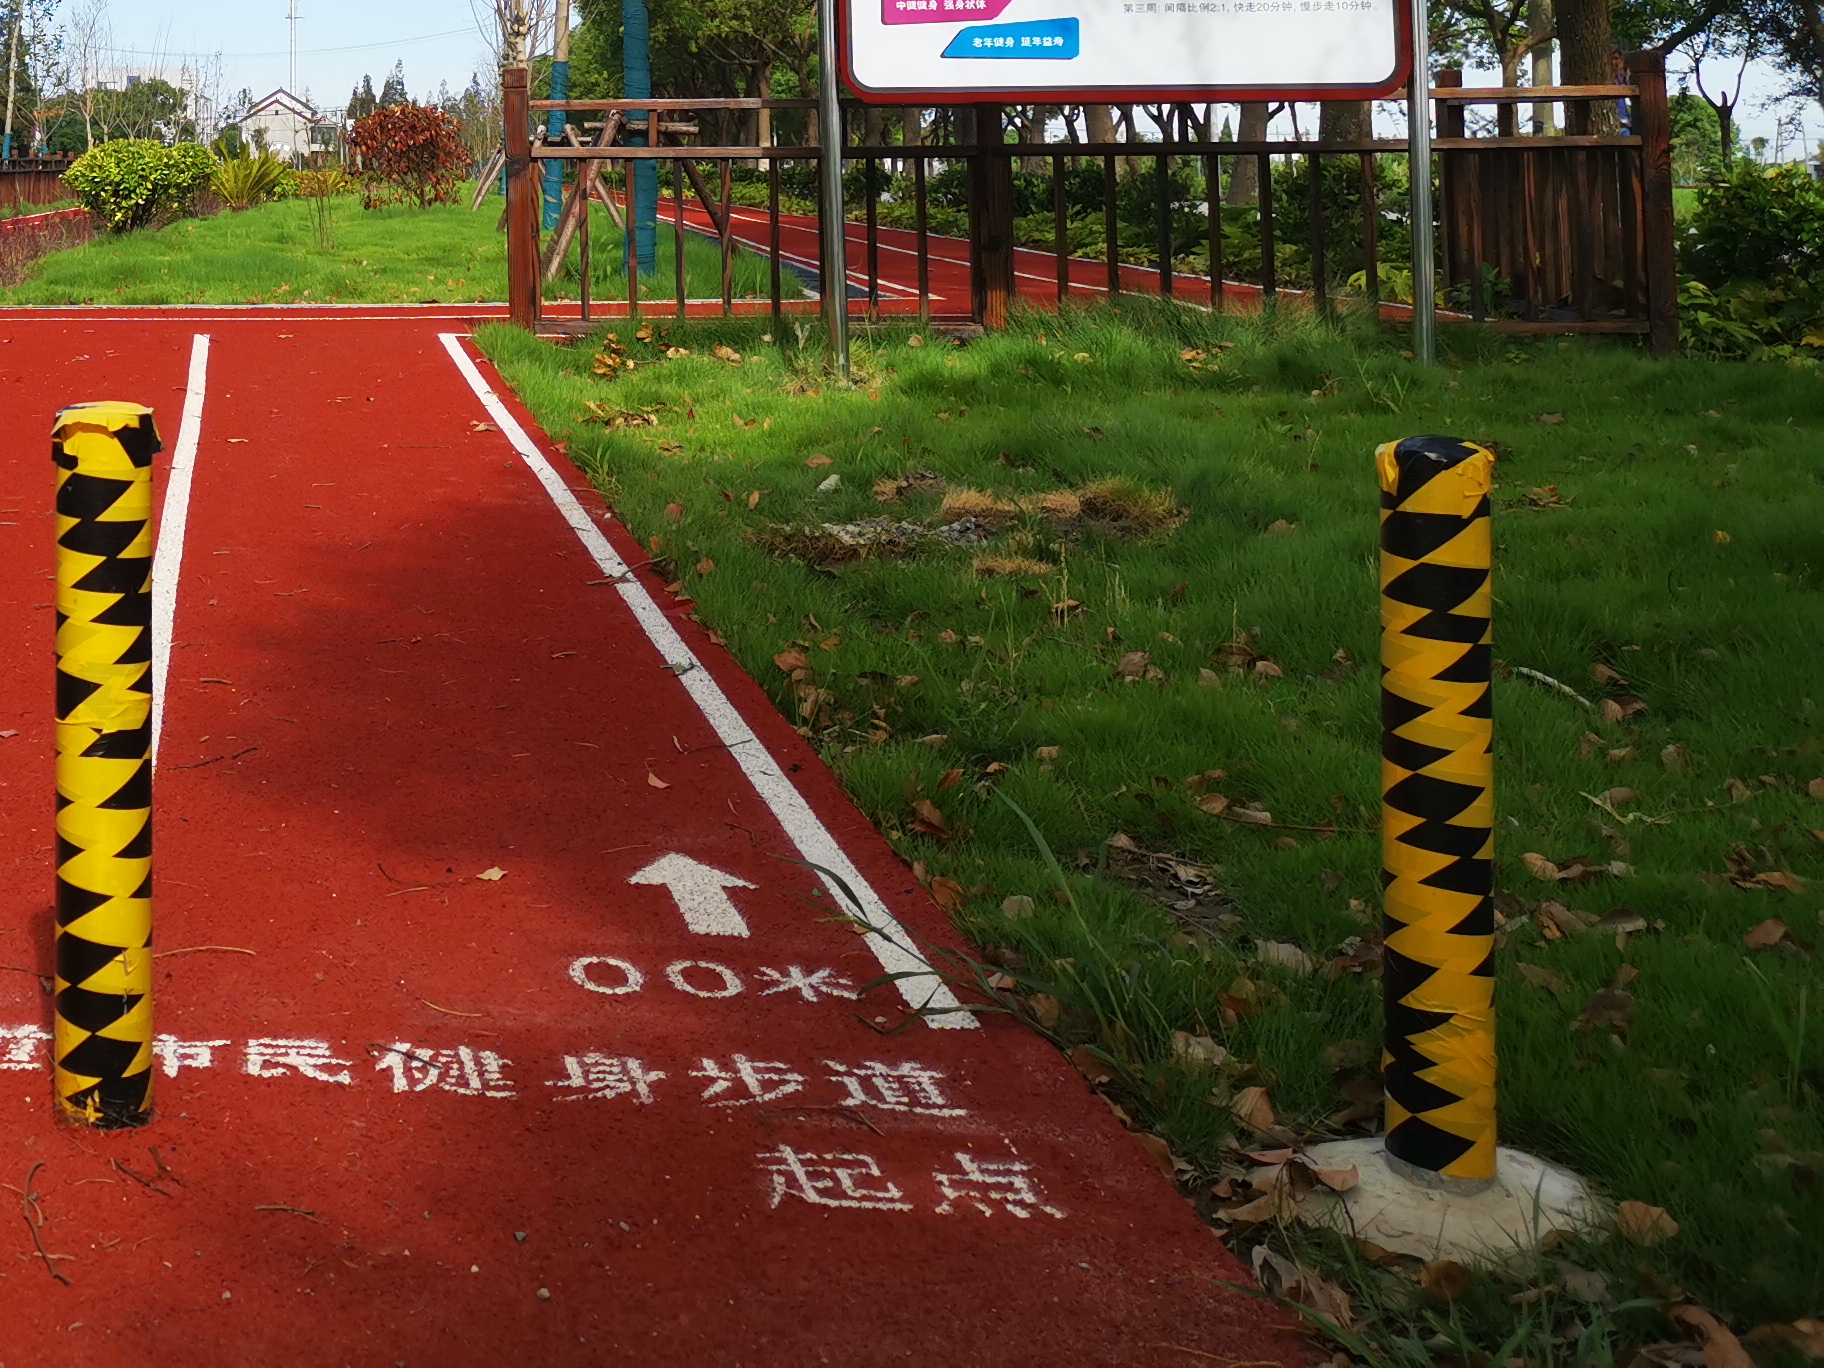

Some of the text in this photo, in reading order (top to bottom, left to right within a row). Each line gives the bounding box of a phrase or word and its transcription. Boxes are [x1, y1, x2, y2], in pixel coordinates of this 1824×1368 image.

[972, 36, 1015, 48] 老年健身
[756, 1143, 1070, 1219] 起点
